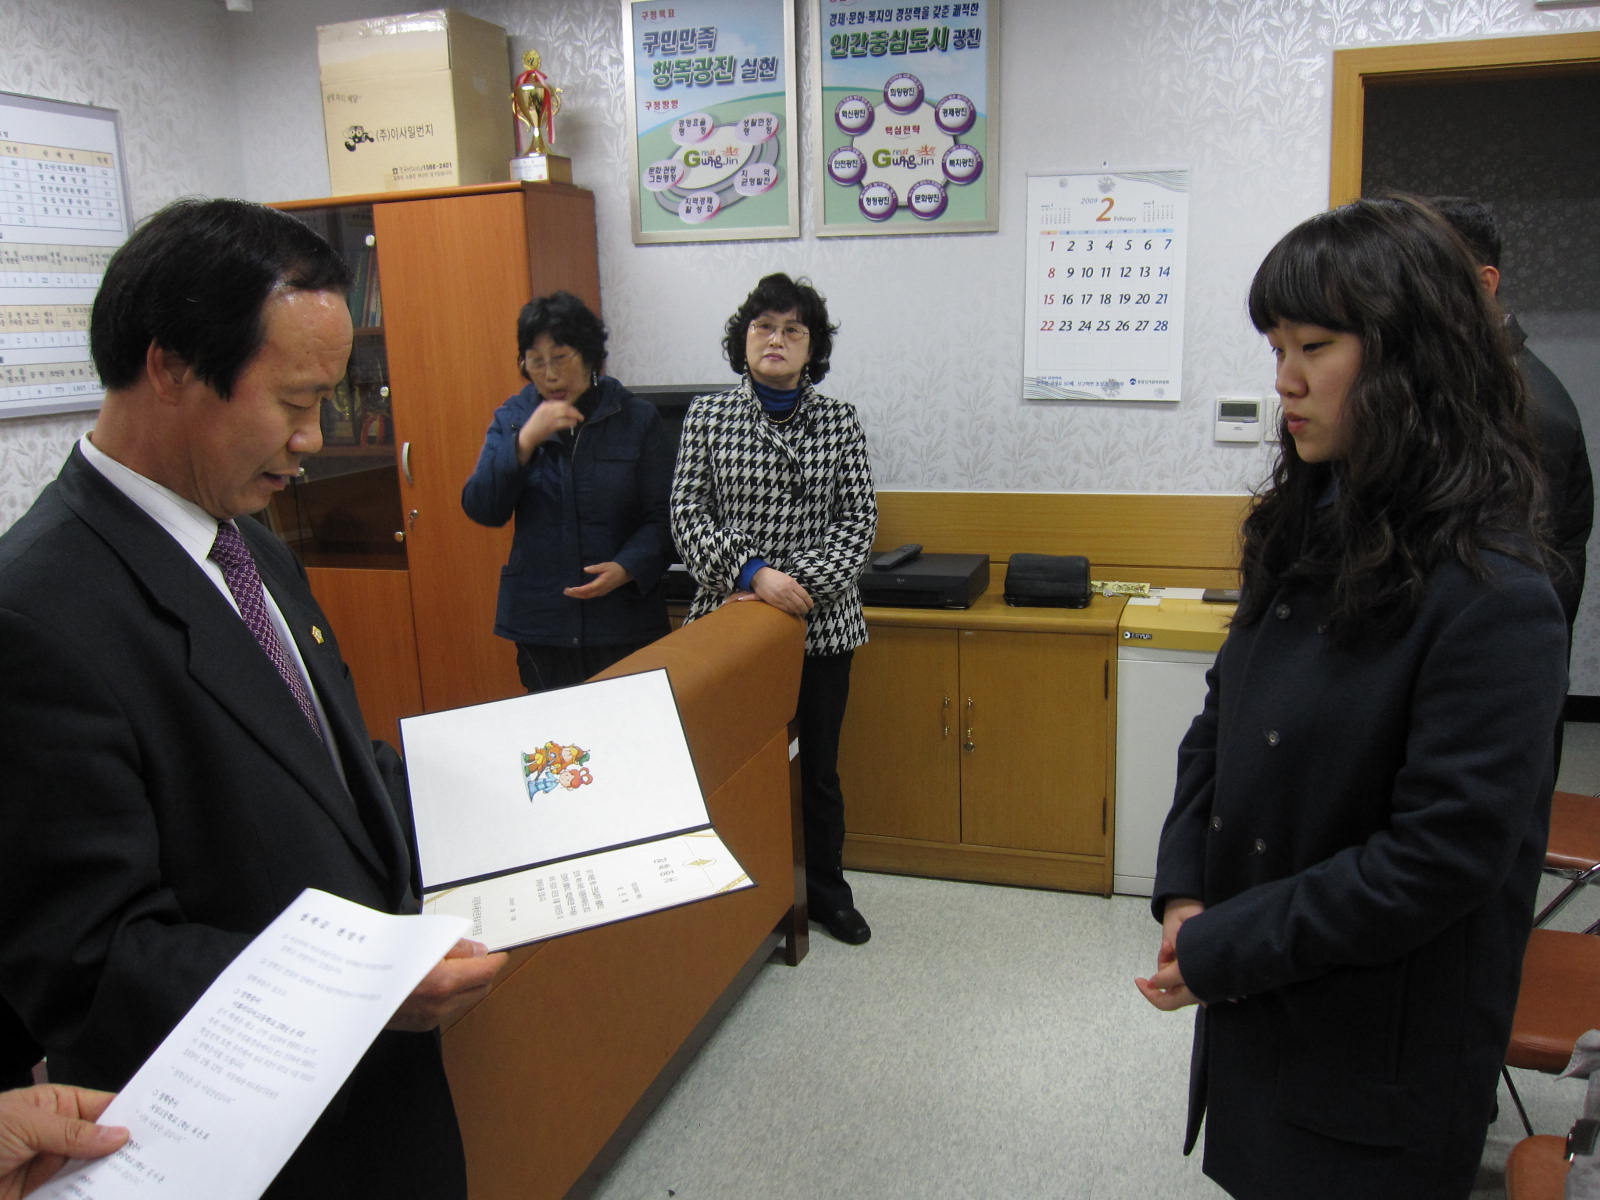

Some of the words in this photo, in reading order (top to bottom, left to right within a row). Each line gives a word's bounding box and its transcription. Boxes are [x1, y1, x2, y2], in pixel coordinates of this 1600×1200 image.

[641, 9, 676, 21] 구정목표
[896, 6, 930, 22] 경쟁력을
[933, 4, 950, 19] 갖춘
[952, 2, 979, 17] 쾌적한
[642, 26, 717, 56] 구민만족
[830, 26, 950, 59] 인간중심도시
[953, 28, 981, 49] 광진
[652, 55, 735, 88] 행복광진
[741, 56, 778, 82] 실현
[645, 100, 679, 111] 구정방향
[942, 108, 968, 117] 경제광진
[376, 124, 434, 142] (주)이사일번지
[885, 125, 920, 136] 핵심전략
[1096, 197, 1115, 222] 2
[1050, 240, 1055, 252] 1
[1066, 240, 1075, 252] 2
[1086, 240, 1094, 251] 3
[1105, 240, 1114, 251] 4
[1125, 240, 1133, 250] 5
[1144, 240, 1152, 250] 6
[1164, 239, 1172, 250] 7
[1048, 268, 1056, 278] 8
[1066, 268, 1074, 278] 9
[1082, 267, 1094, 278] 10
[1101, 267, 1111, 278] 11
[1120, 267, 1132, 278] 12
[1140, 266, 1150, 278] 13
[1158, 266, 1170, 278] 14
[1044, 294, 1055, 304] 15
[1062, 294, 1074, 304] 16
[1081, 294, 1093, 304] 17
[1100, 294, 1112, 304] 18
[1119, 294, 1131, 304] 19
[1135, 294, 1150, 304] 20
[1155, 294, 1168, 304] 21
[1040, 320, 1055, 332] 22
[1058, 320, 1072, 332] 23
[1078, 320, 1092, 332] 24
[1096, 320, 1110, 332] 25
[1115, 320, 1130, 332] 26
[1135, 320, 1150, 332] 27
[1154, 320, 1168, 332] 28
